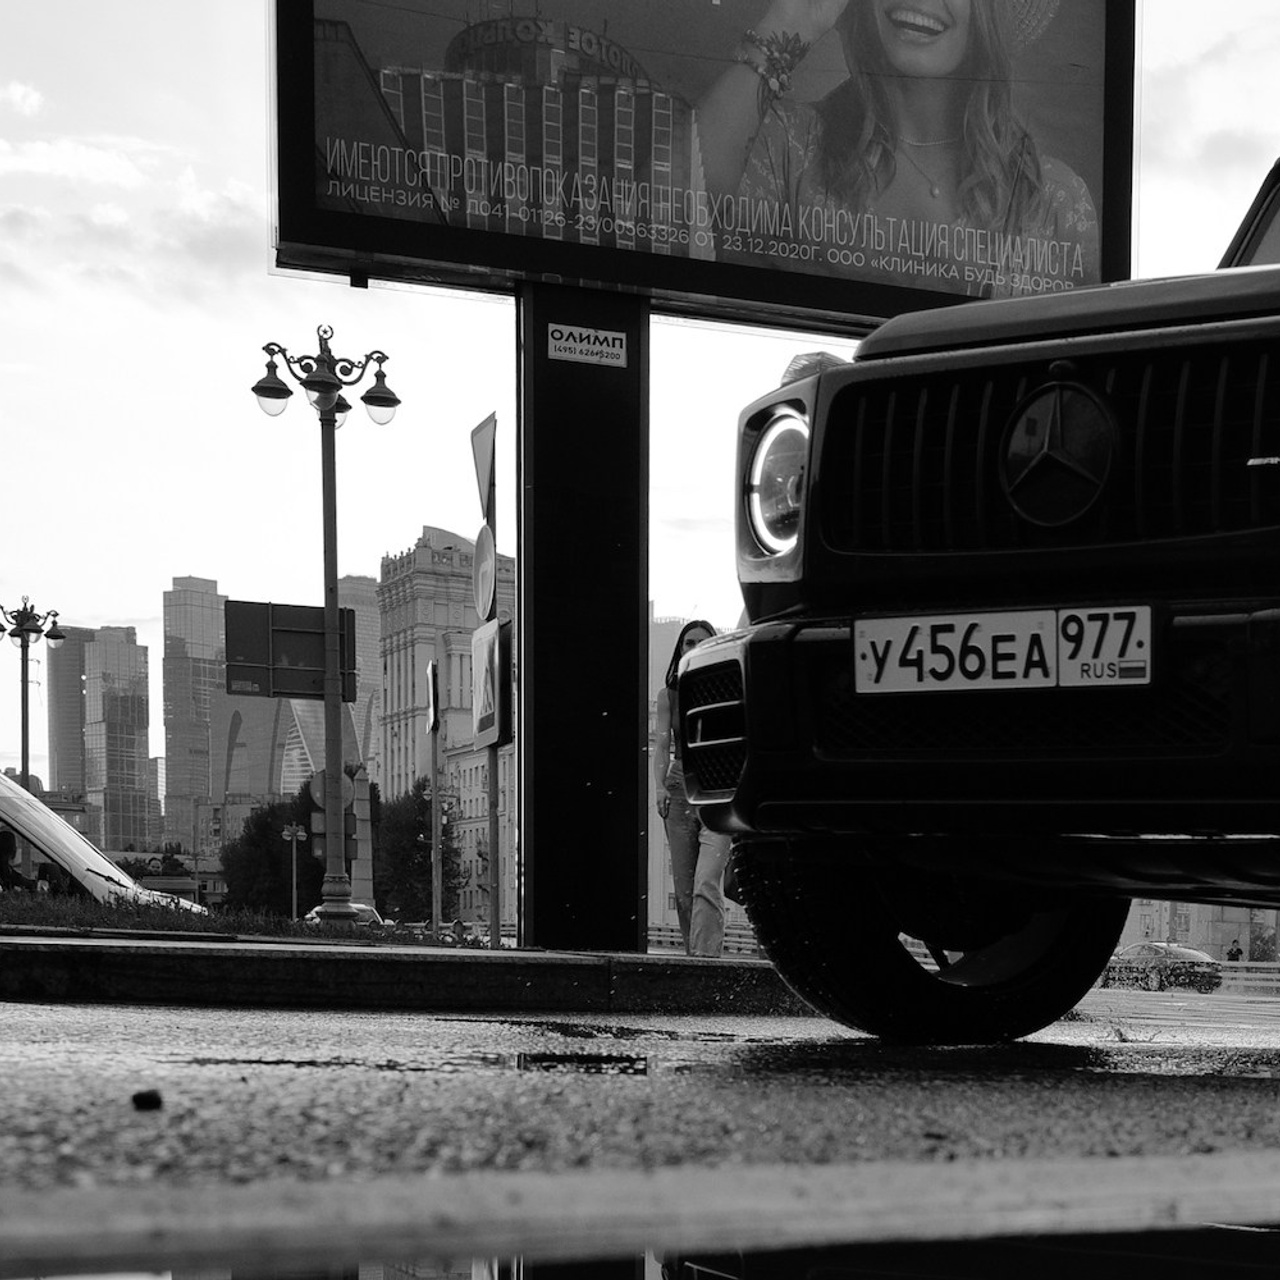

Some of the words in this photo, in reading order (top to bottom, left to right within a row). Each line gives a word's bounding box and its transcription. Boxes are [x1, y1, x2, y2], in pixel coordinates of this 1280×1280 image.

[326, 136, 431, 188] ИМЕЮТСЯ
[659, 186, 793, 240] НЕОБХОДИМА
[798, 205, 949, 259] КОНСУЛЬТАЦИЯ
[953, 226, 1084, 279] СПЕЦИАЛИСТА
[327, 180, 434, 209] ЛИЦЕНЗИЯ
[694, 230, 717, 248] ОТ
[722, 234, 823, 262] 23.12.2020Г.
[826, 248, 865, 267] ООО
[871, 256, 959, 279] «КЛИНИКА
[965, 266, 1006, 286] БУДЬ
[551, 328, 623, 349] ОЛИМП
[554, 345, 577, 355] (495)
[1061, 611, 1137, 660] 977
[1080, 662, 1117, 679] RUS
